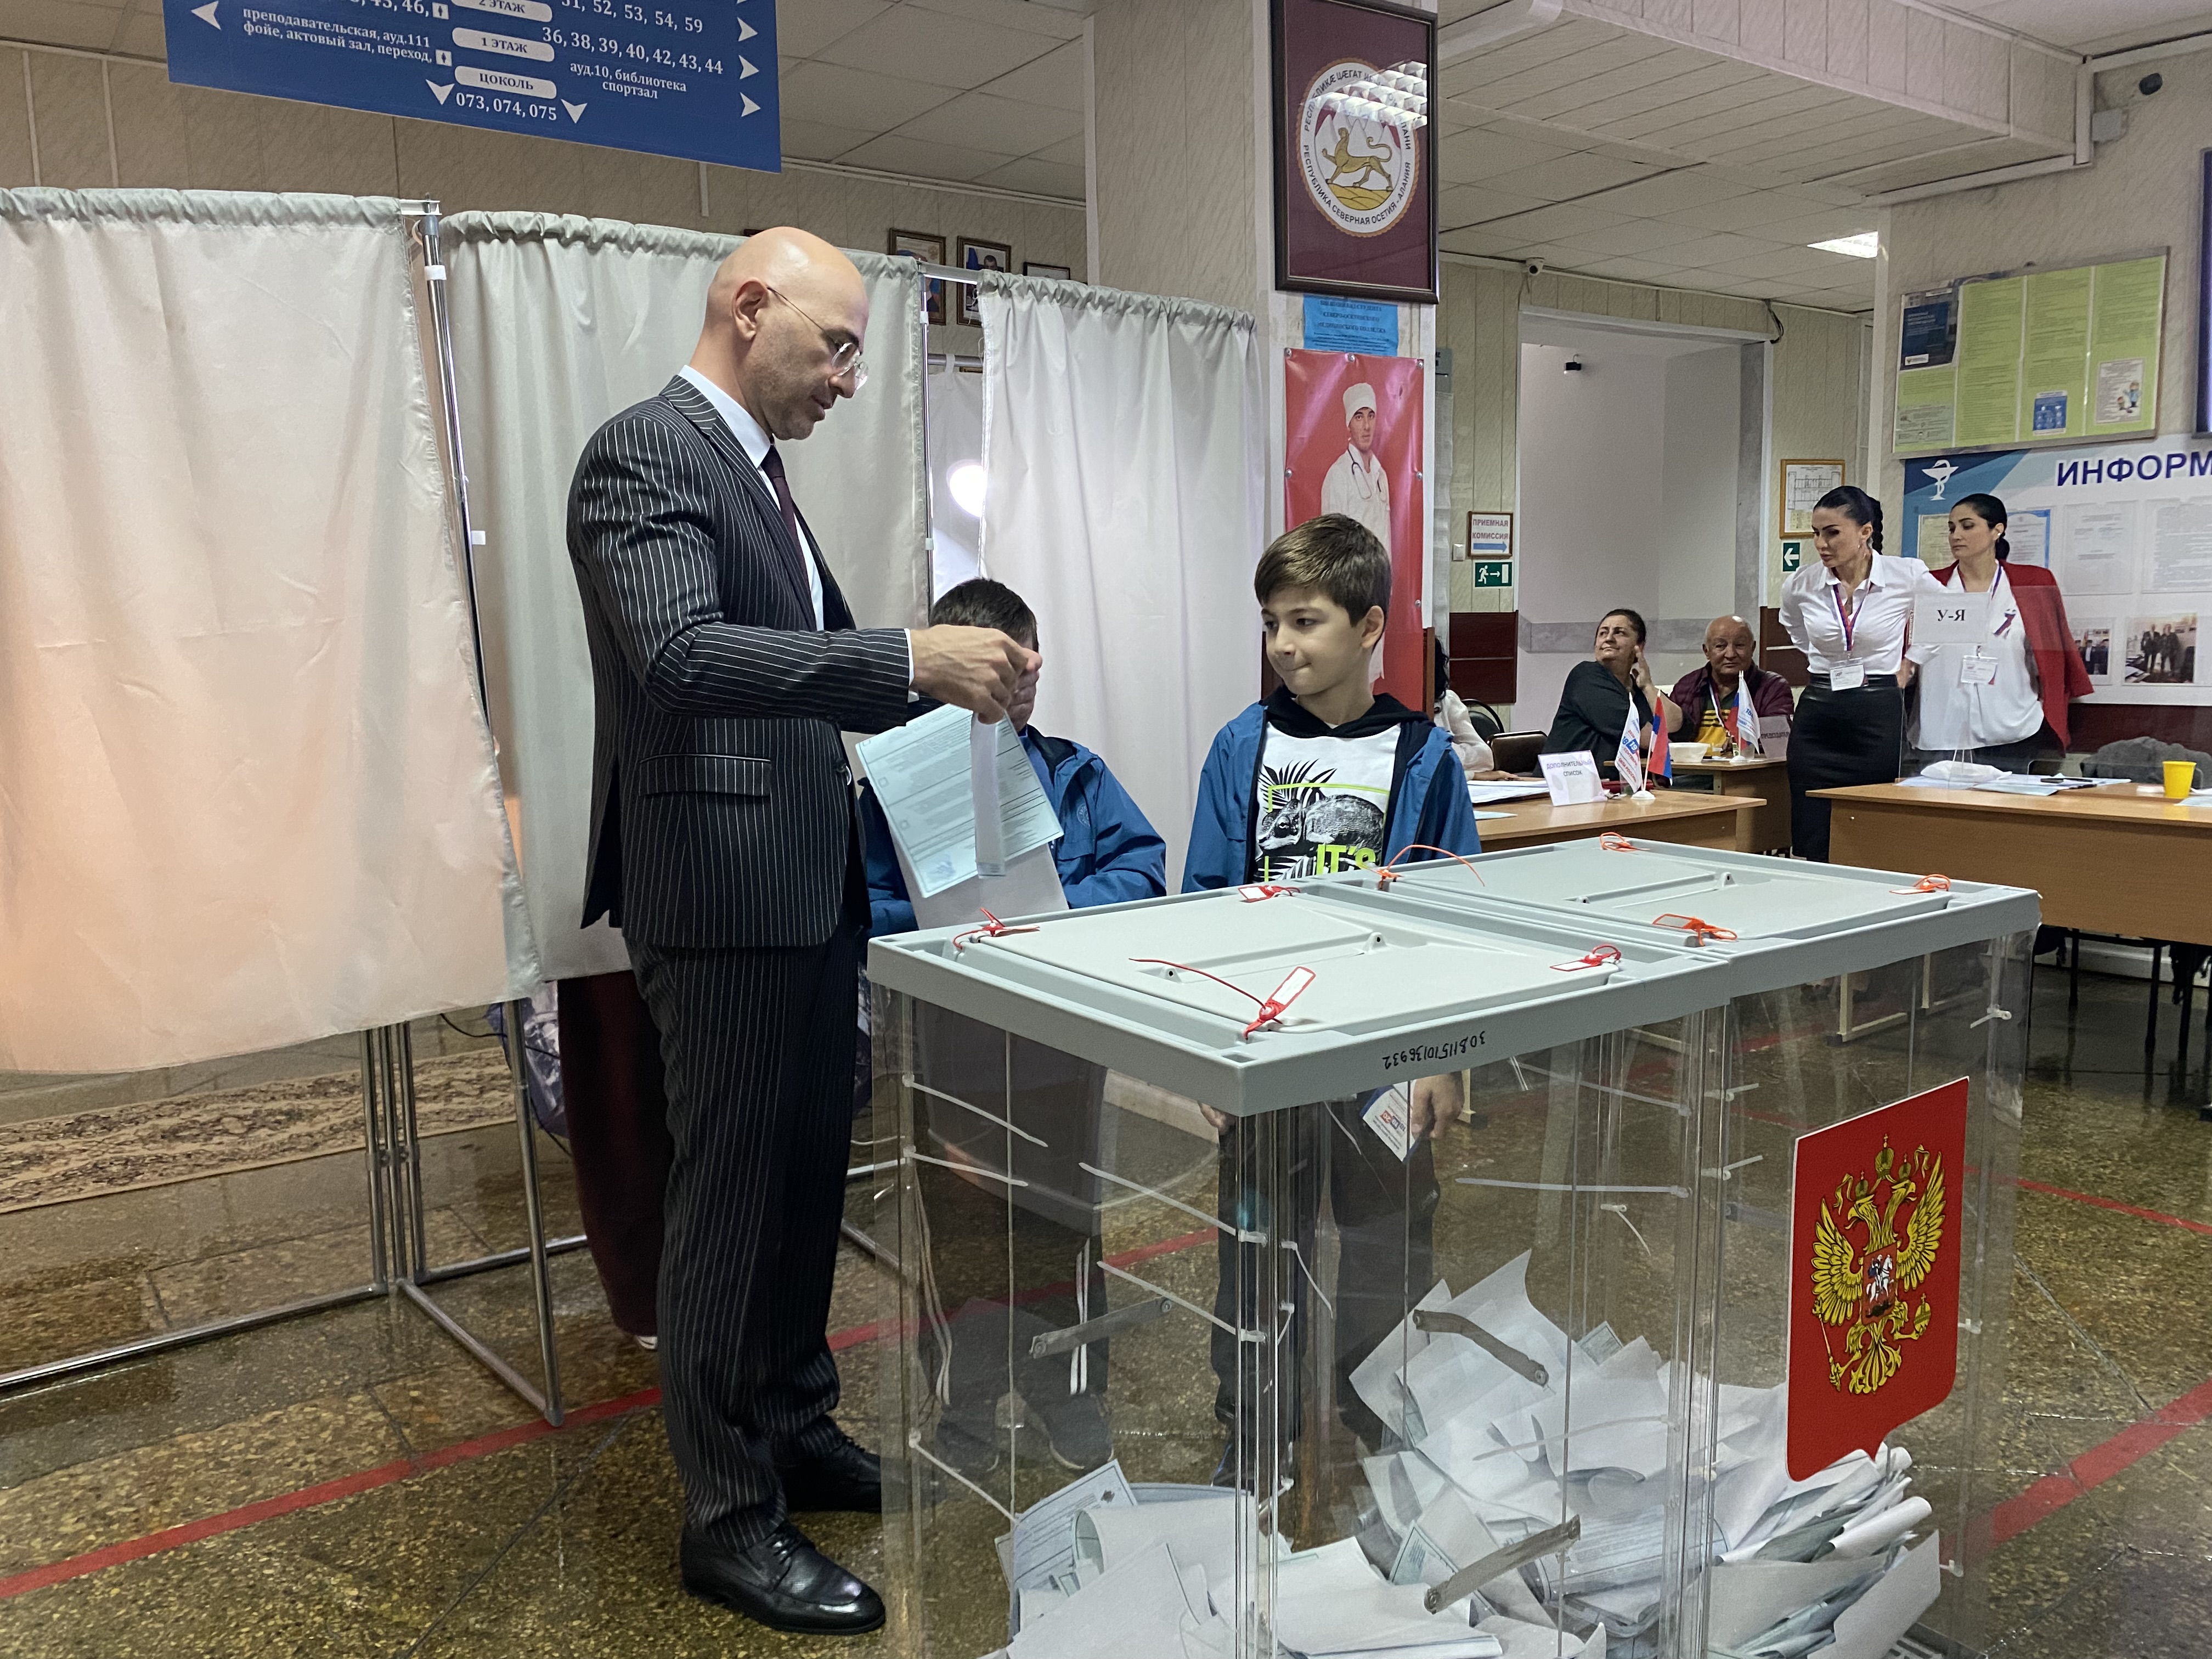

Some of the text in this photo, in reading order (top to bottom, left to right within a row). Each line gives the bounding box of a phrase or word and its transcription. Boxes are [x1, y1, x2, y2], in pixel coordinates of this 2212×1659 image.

[402, 0, 429, 17] 46,
[489, 0, 525, 13] ЭТАЖ
[594, 0, 616, 18] 52,
[624, 4, 647, 25] 53,
[655, 11, 678, 30] 54,
[685, 17, 703, 33] 59
[243, 8, 430, 48] преподавательская, ауд.111
[244, 21, 432, 63] фойе, актовый зал, переход,
[482, 37, 527, 53] 1 ЭТАЖ
[543, 27, 723, 74] 36, 38, 39, 40, 42, 43, 44
[479, 73, 533, 89] ЦОКОЛЬ
[570, 63, 686, 92] ауд.10, библиотека
[603, 81, 658, 99] спортзал
[456, 92, 557, 121] 073, 074, 075
[1304, 145, 1332, 207] РЕСПУБЛИКА
[1332, 205, 1370, 225] СЕВЕРНАЯ
[1372, 202, 1397, 224] ОСЕТИЯ
[1398, 162, 1411, 201] АЛАНИЯ
[2057, 450, 2212, 486] ИНФОРМ
[1937, 609, 1966, 622] У-Я
[1629, 741, 1638, 750] 19
[1547, 759, 1593, 769] ДОПОЛНИТЕЛЬНЫЙ
